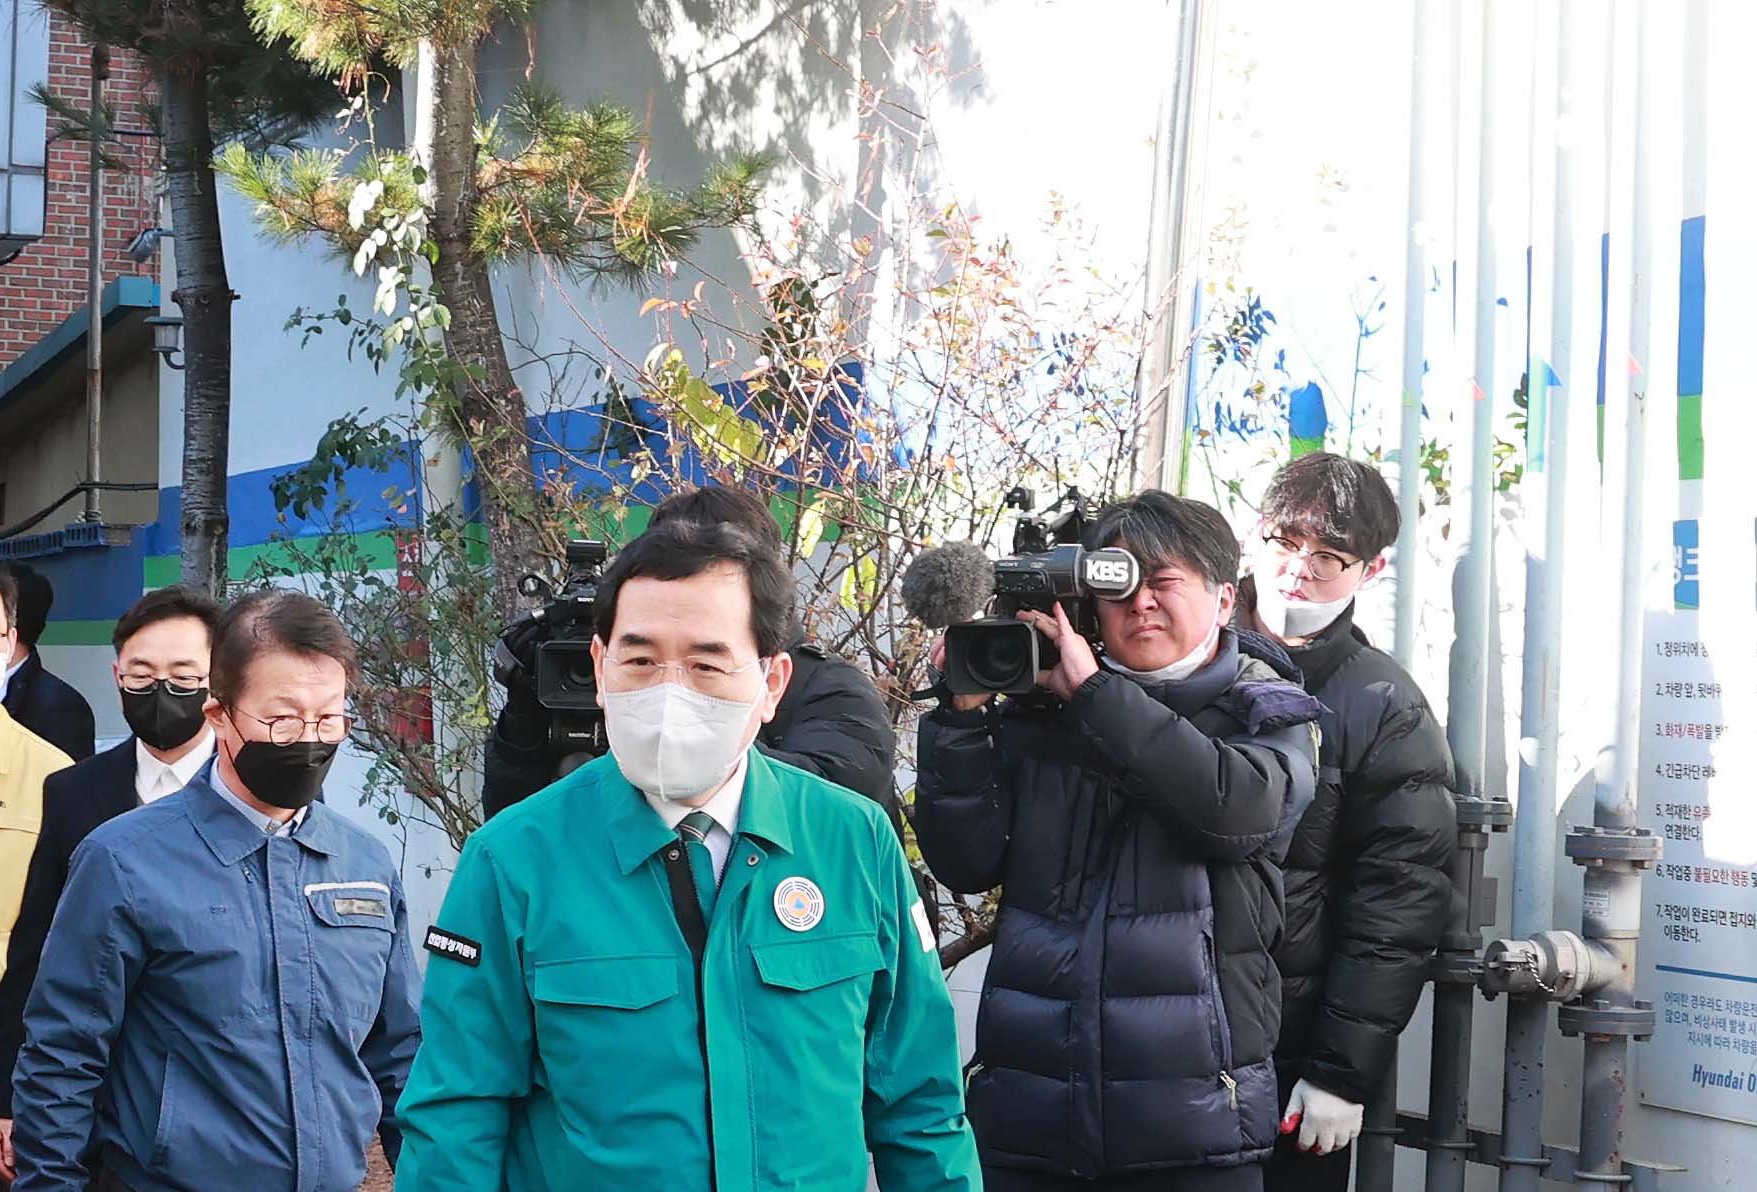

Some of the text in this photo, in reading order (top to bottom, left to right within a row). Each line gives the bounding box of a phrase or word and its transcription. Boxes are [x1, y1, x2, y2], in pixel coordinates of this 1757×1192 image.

[1086, 559, 1129, 583] KBS
[1665, 641, 1699, 657] 정위치에
[1666, 682, 1683, 699] 차량
[1666, 763, 1701, 780] 긴급차단
[1666, 864, 1692, 882] 작업중
[1693, 866, 1729, 885] 불필요한
[1730, 870, 1749, 887] 행동
[1664, 904, 1690, 921] 작업이
[1691, 907, 1728, 926] 완료되면
[1690, 994, 1723, 1012] 경우라도
[1692, 1063, 1744, 1091] Hyundai
